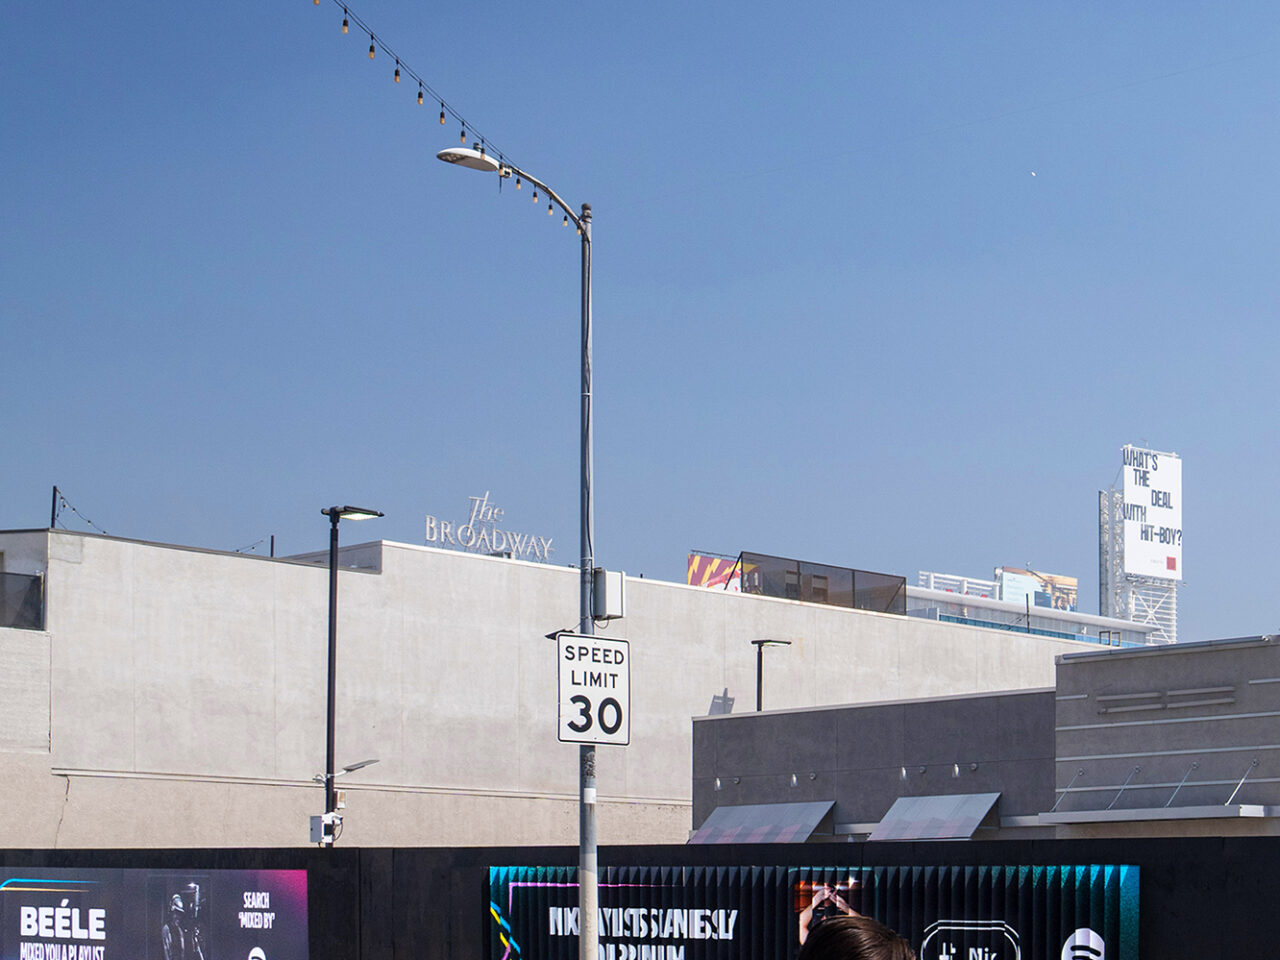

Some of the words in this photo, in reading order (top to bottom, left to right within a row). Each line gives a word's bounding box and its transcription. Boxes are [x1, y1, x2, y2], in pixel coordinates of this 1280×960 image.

[1123, 449, 1159, 471] WHAT'S
[1133, 468, 1150, 487] THE
[1151, 489, 1174, 509] DEAL
[468, 491, 505, 537] The
[1123, 503, 1147, 523] WITH
[425, 514, 555, 560] BROADWAY
[1140, 524, 1183, 546] HIT-BOY?
[564, 645, 625, 665] SPEED
[571, 670, 619, 689] LIMIT
[567, 694, 623, 735] 30
[242, 891, 270, 909] SEARCH
[20, 898, 107, 940] BEÉLE
